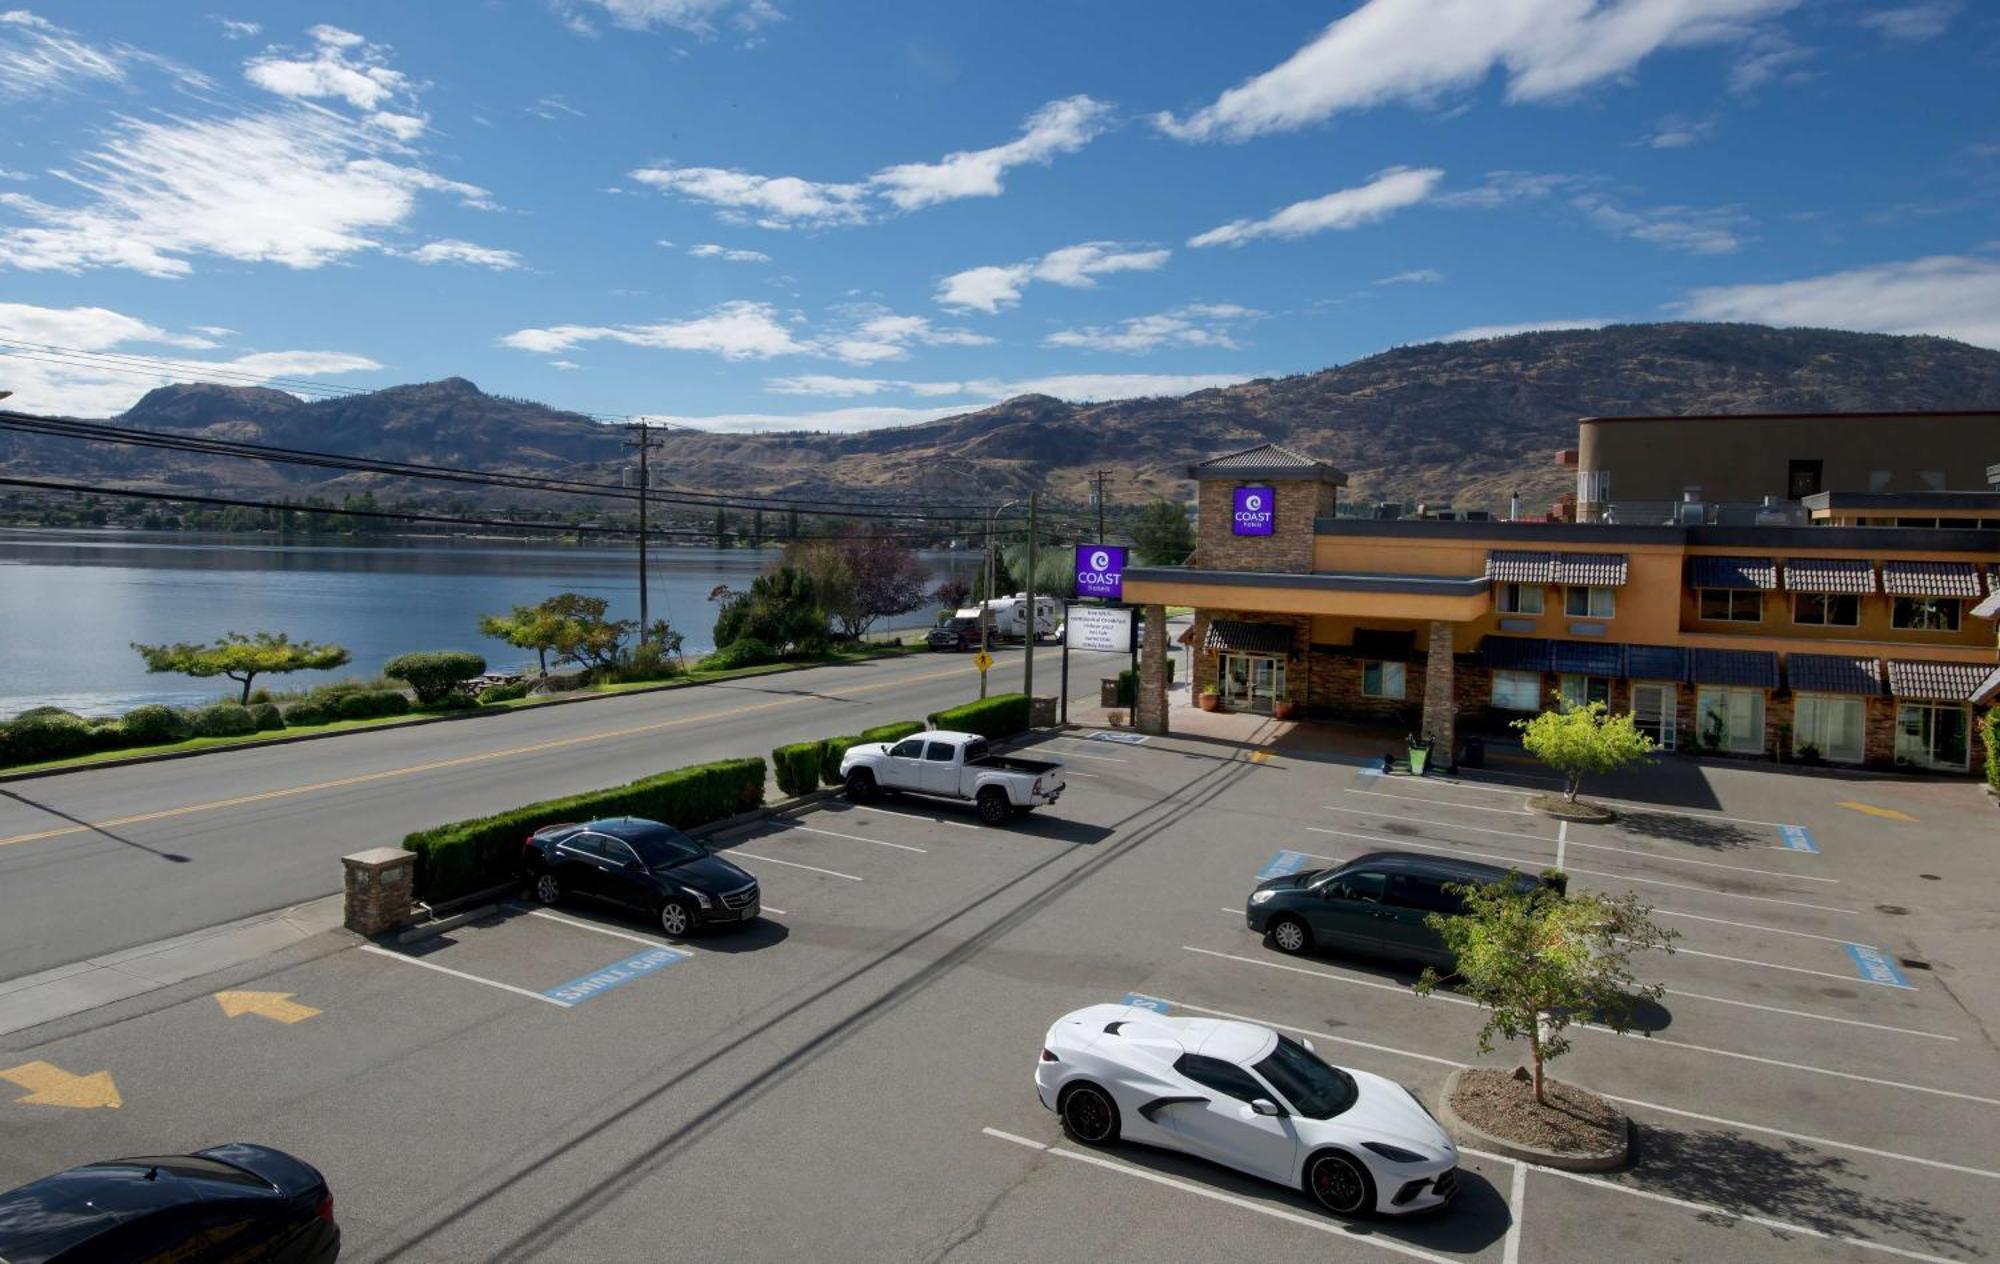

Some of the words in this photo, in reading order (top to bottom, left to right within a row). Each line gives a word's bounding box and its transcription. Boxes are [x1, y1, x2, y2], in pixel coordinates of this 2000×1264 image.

[1235, 511, 1272, 522] COAST
[1078, 571, 1122, 585] COAST
[556, 969, 635, 1000] SMALL
[627, 950, 677, 970] CAR
